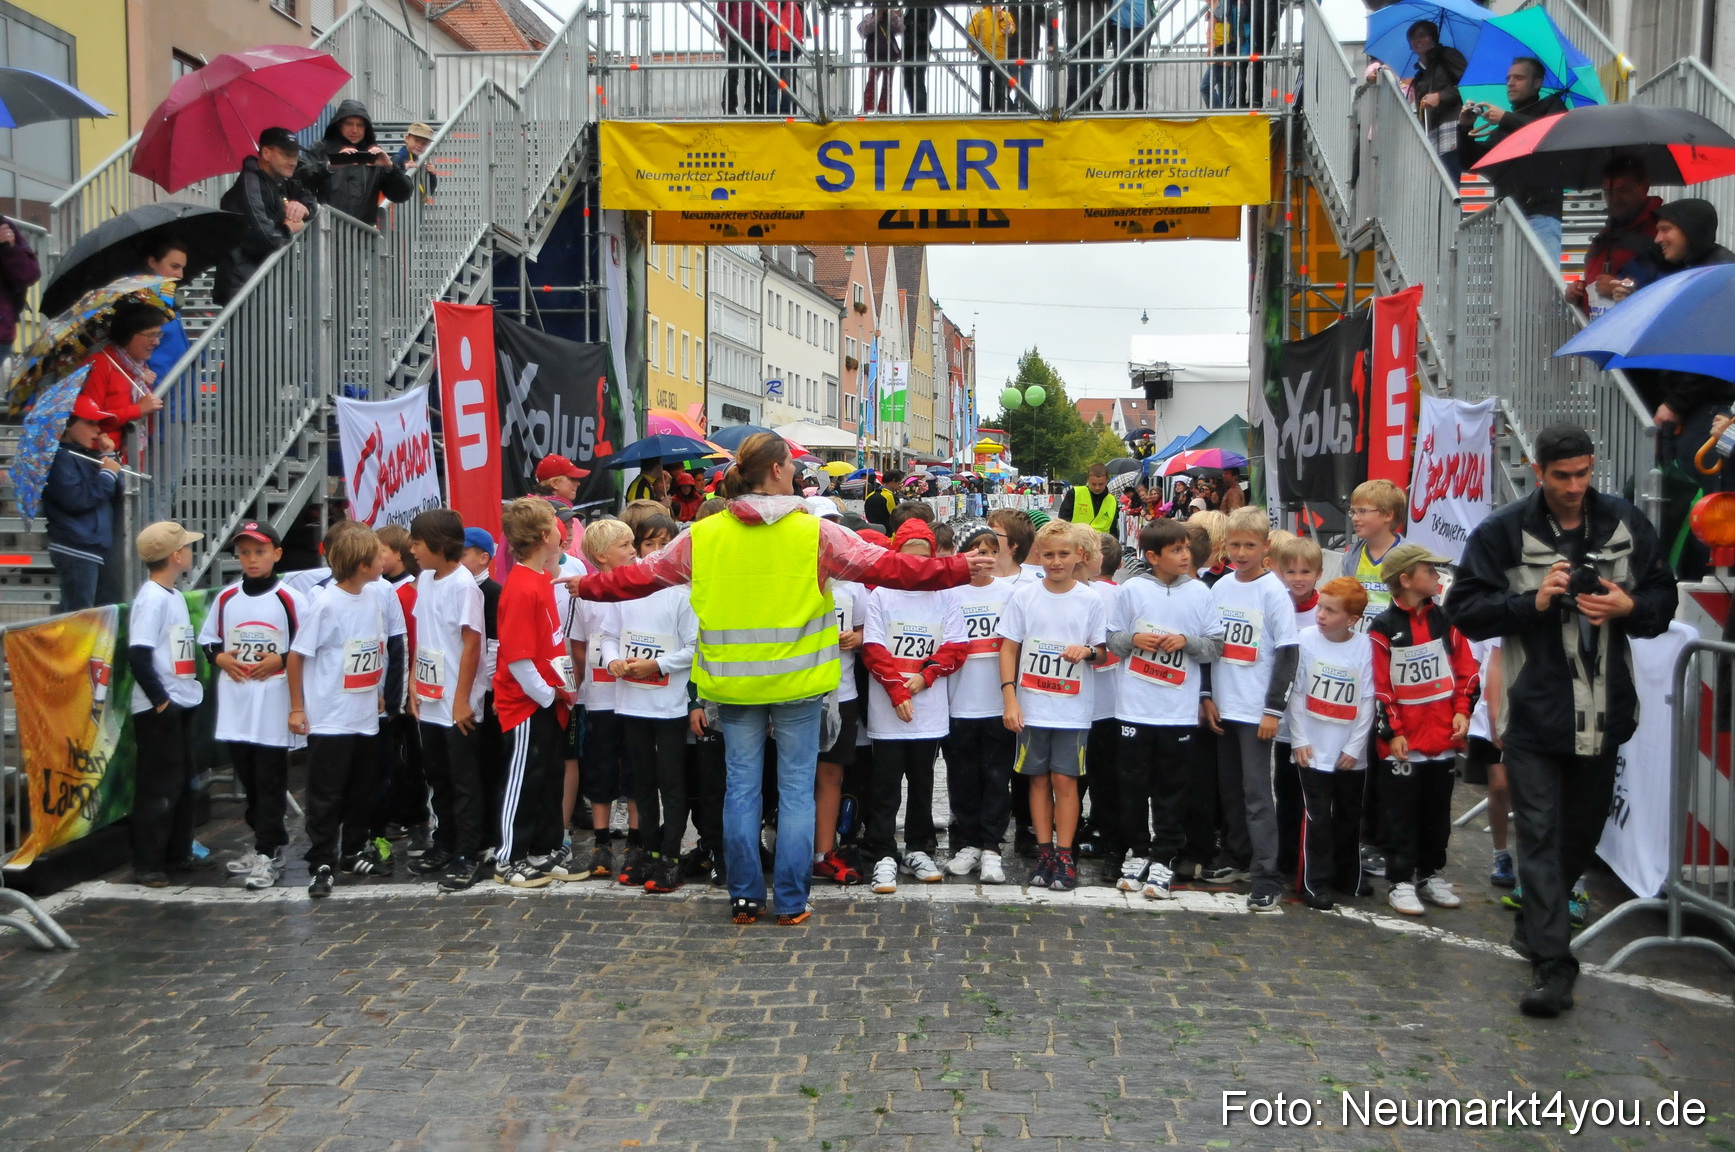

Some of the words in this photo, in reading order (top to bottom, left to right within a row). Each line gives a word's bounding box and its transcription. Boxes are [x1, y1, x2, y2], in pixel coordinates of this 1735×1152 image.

[815, 138, 1045, 193] START
[1085, 166, 1165, 179] Neumarkter
[1167, 165, 1231, 179] Stadtlauf
[635, 168, 713, 182] Neumarkter
[716, 169, 777, 182] Stadtlauf
[1360, 582, 1390, 592] OCK
[1220, 620, 1254, 645] 180
[892, 635, 936, 659] 7234
[1143, 663, 1169, 679] David
[1395, 655, 1440, 684] 7367
[1037, 678, 1062, 691] Lukas
[1310, 673, 1355, 704] 7170
[1121, 725, 1137, 738] 159
[1391, 761, 1412, 776] 30
